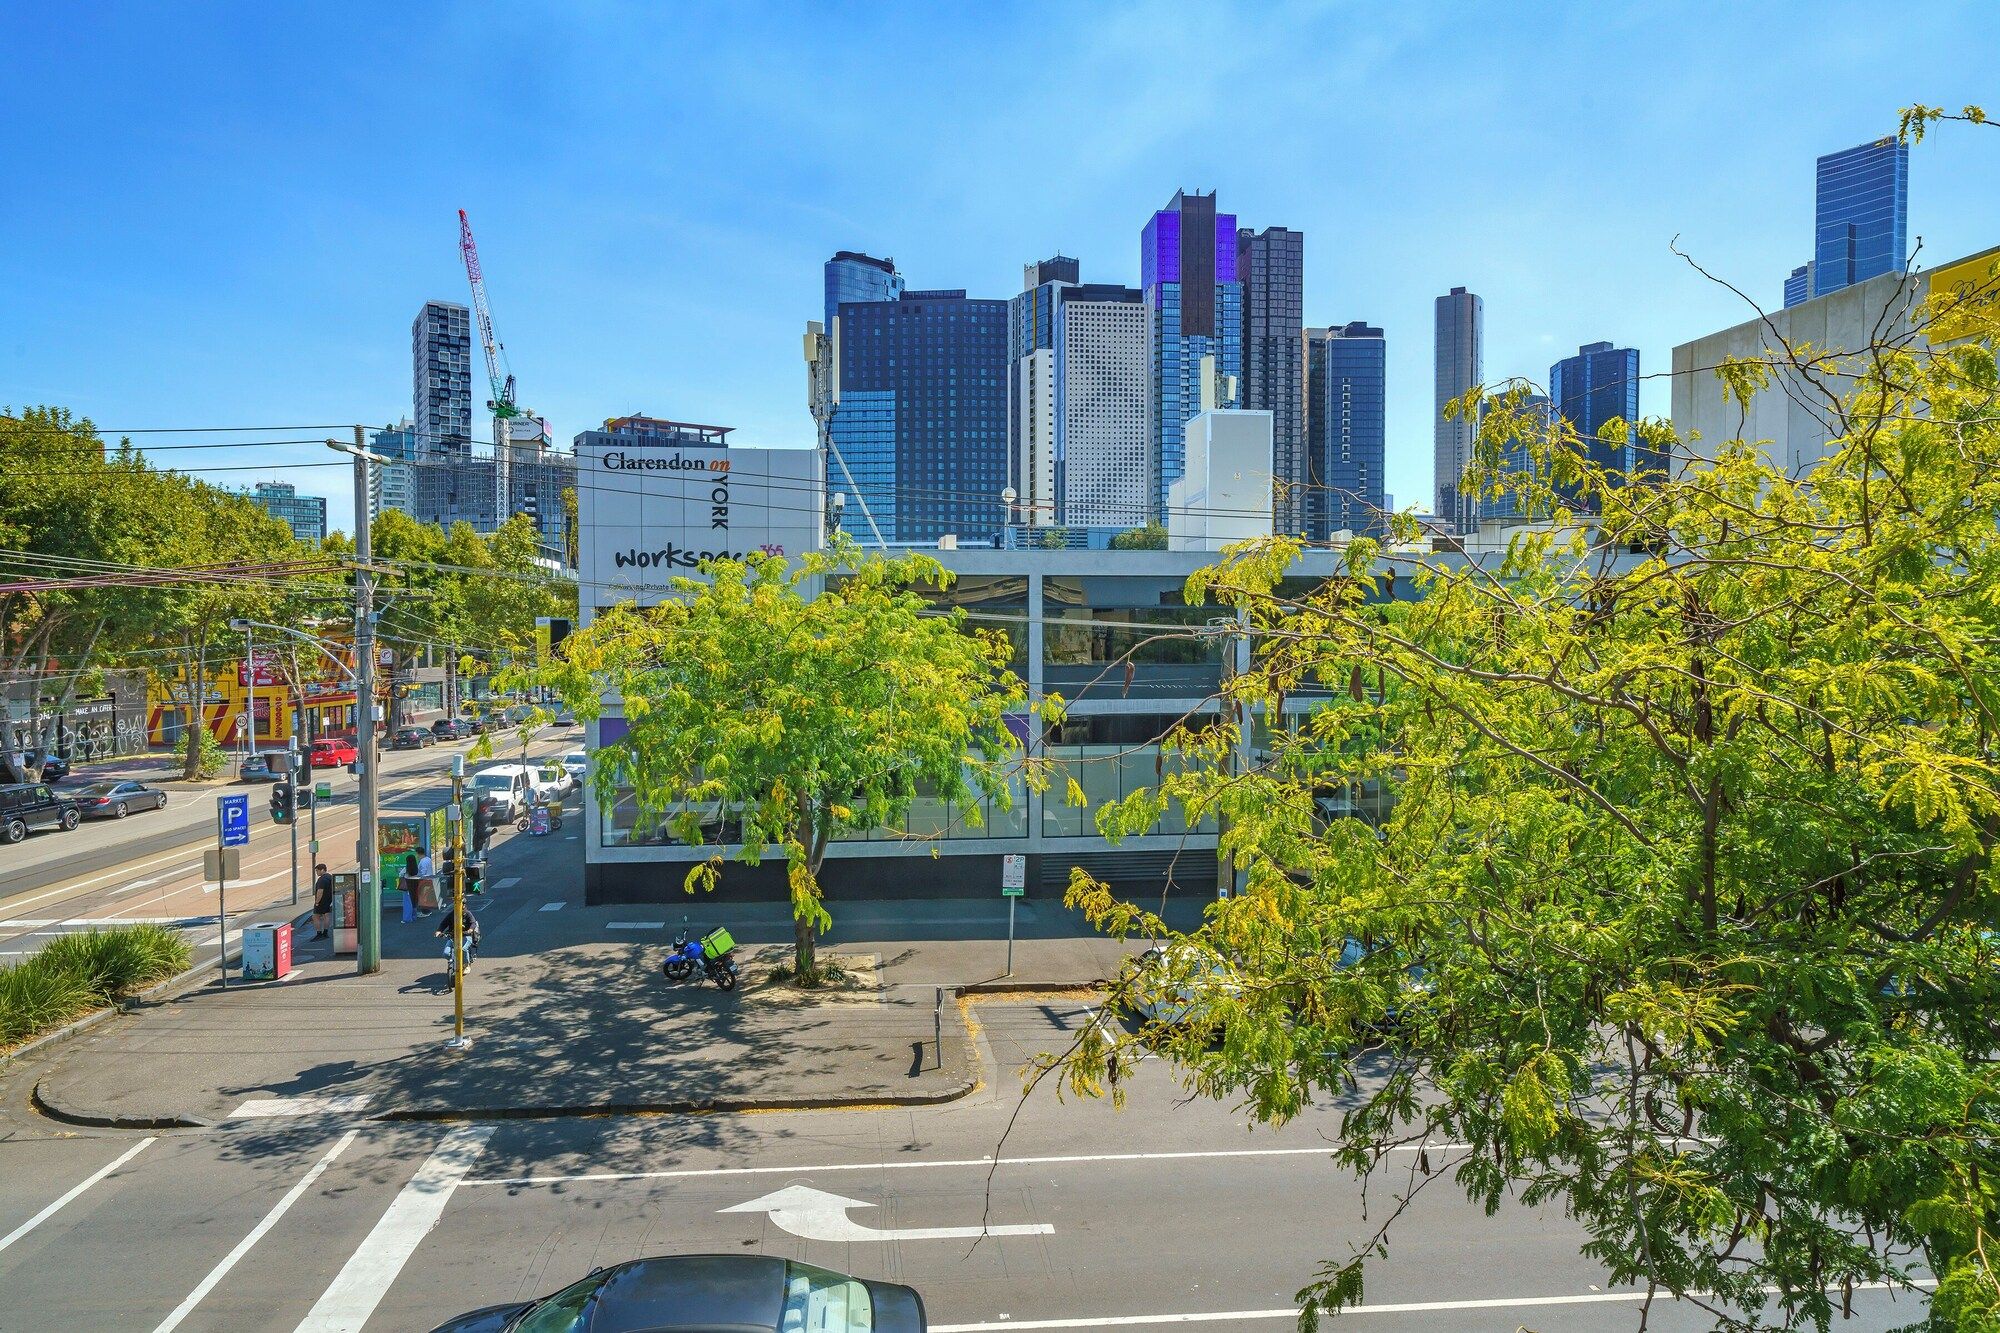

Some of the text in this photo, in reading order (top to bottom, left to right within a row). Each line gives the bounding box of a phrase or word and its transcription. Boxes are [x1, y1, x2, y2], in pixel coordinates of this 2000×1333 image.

[603, 452, 731, 472] Clarendon on
[711, 475, 729, 530] YORK
[172, 691, 222, 699] TOLS
[228, 807, 243, 824] P
